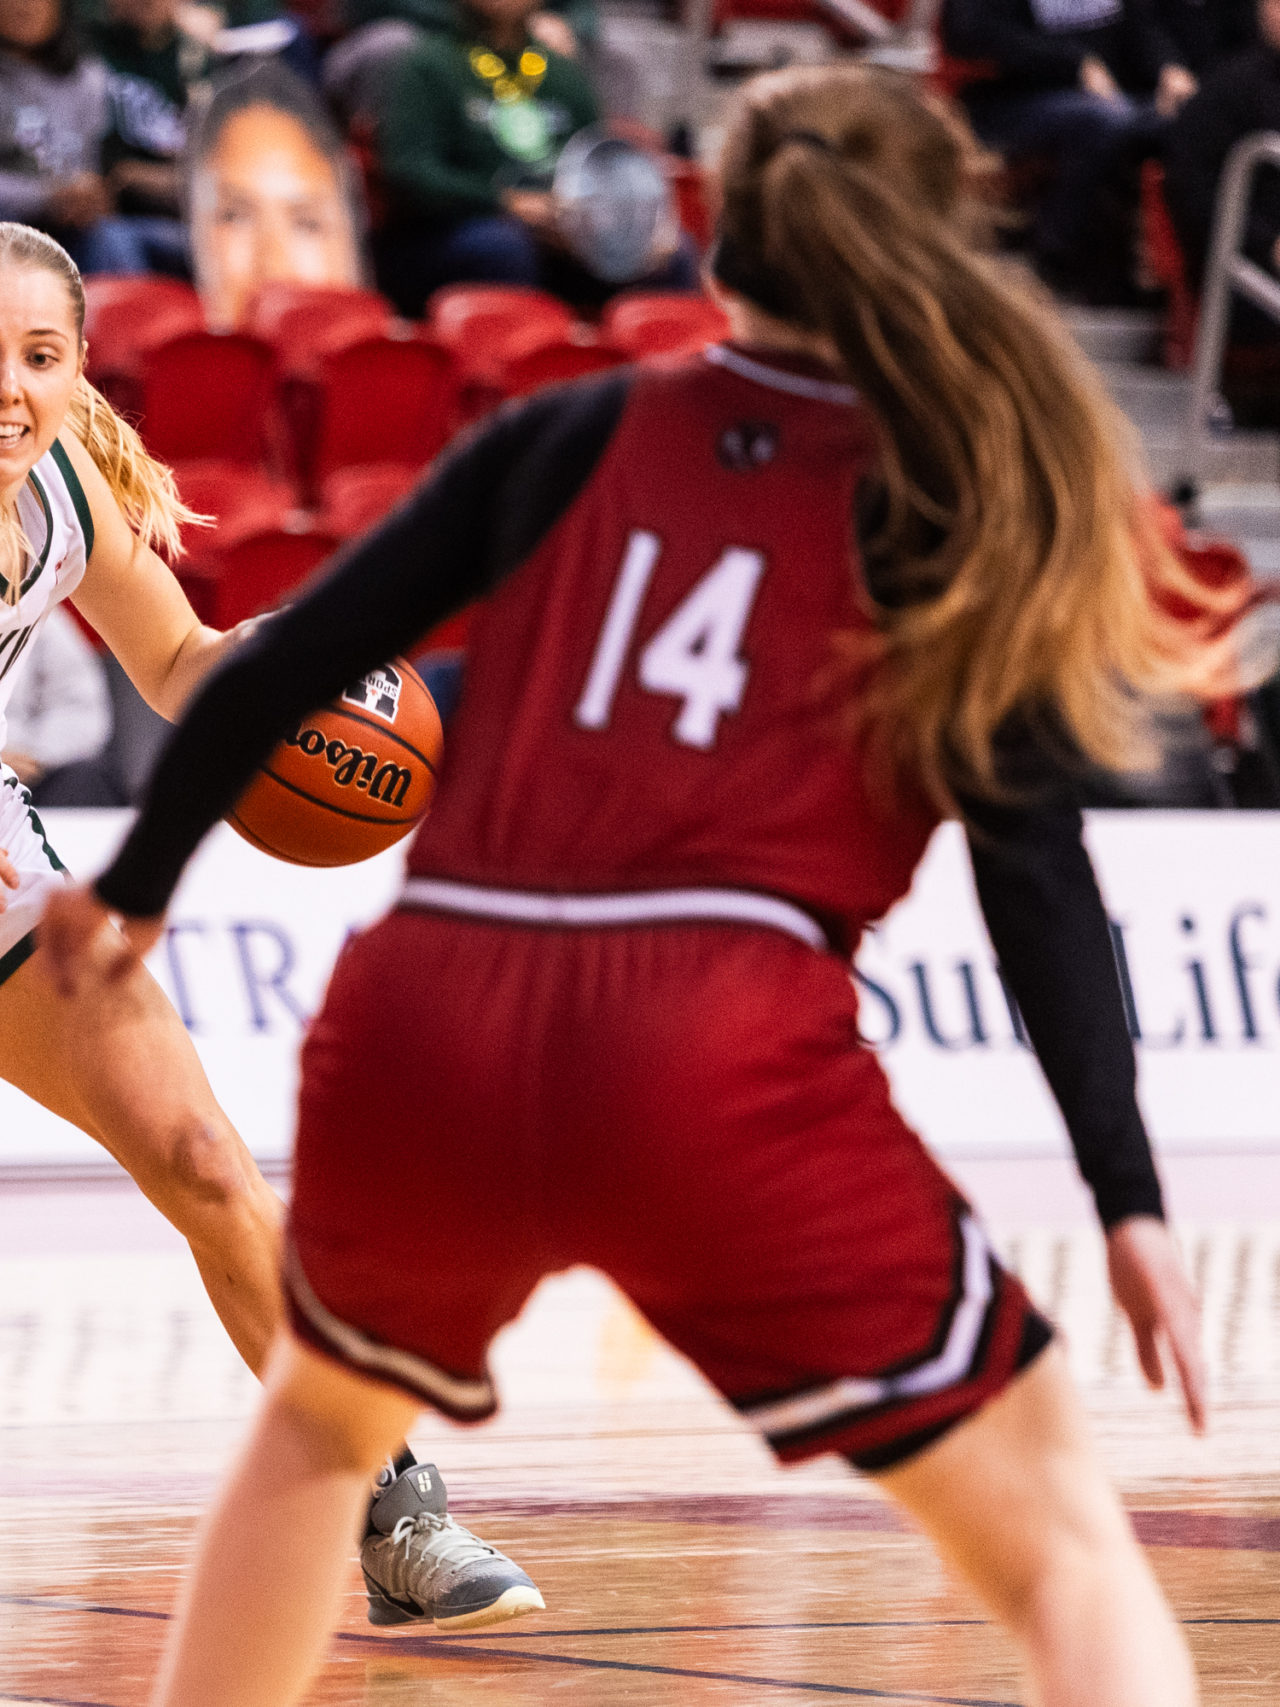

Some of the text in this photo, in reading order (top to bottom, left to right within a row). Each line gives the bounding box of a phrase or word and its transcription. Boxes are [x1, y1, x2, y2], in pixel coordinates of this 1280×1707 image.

[575, 528, 766, 750] 14
[286, 728, 413, 808] Wilso
[856, 902, 1280, 1053] Su Lif
